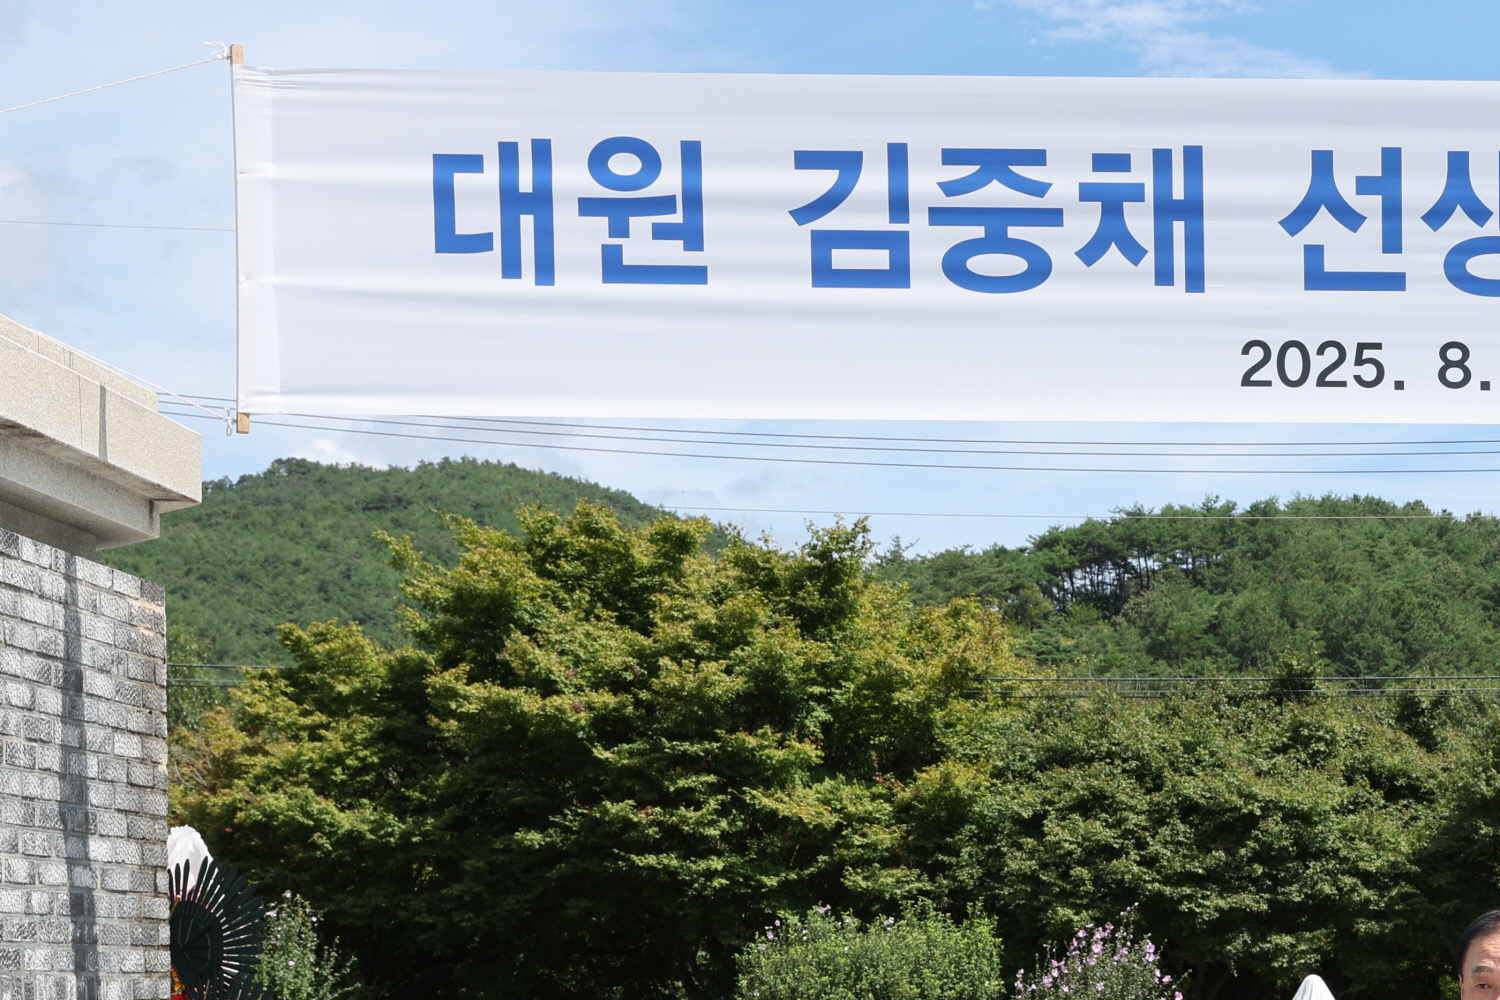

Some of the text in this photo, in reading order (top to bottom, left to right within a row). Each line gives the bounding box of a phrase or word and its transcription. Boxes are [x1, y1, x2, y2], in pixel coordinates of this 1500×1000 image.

[433, 137, 708, 286] 대원
[789, 143, 1205, 294] 김중채
[1241, 340, 1404, 390] 2025.
[1438, 342, 1490, 391] 8.
